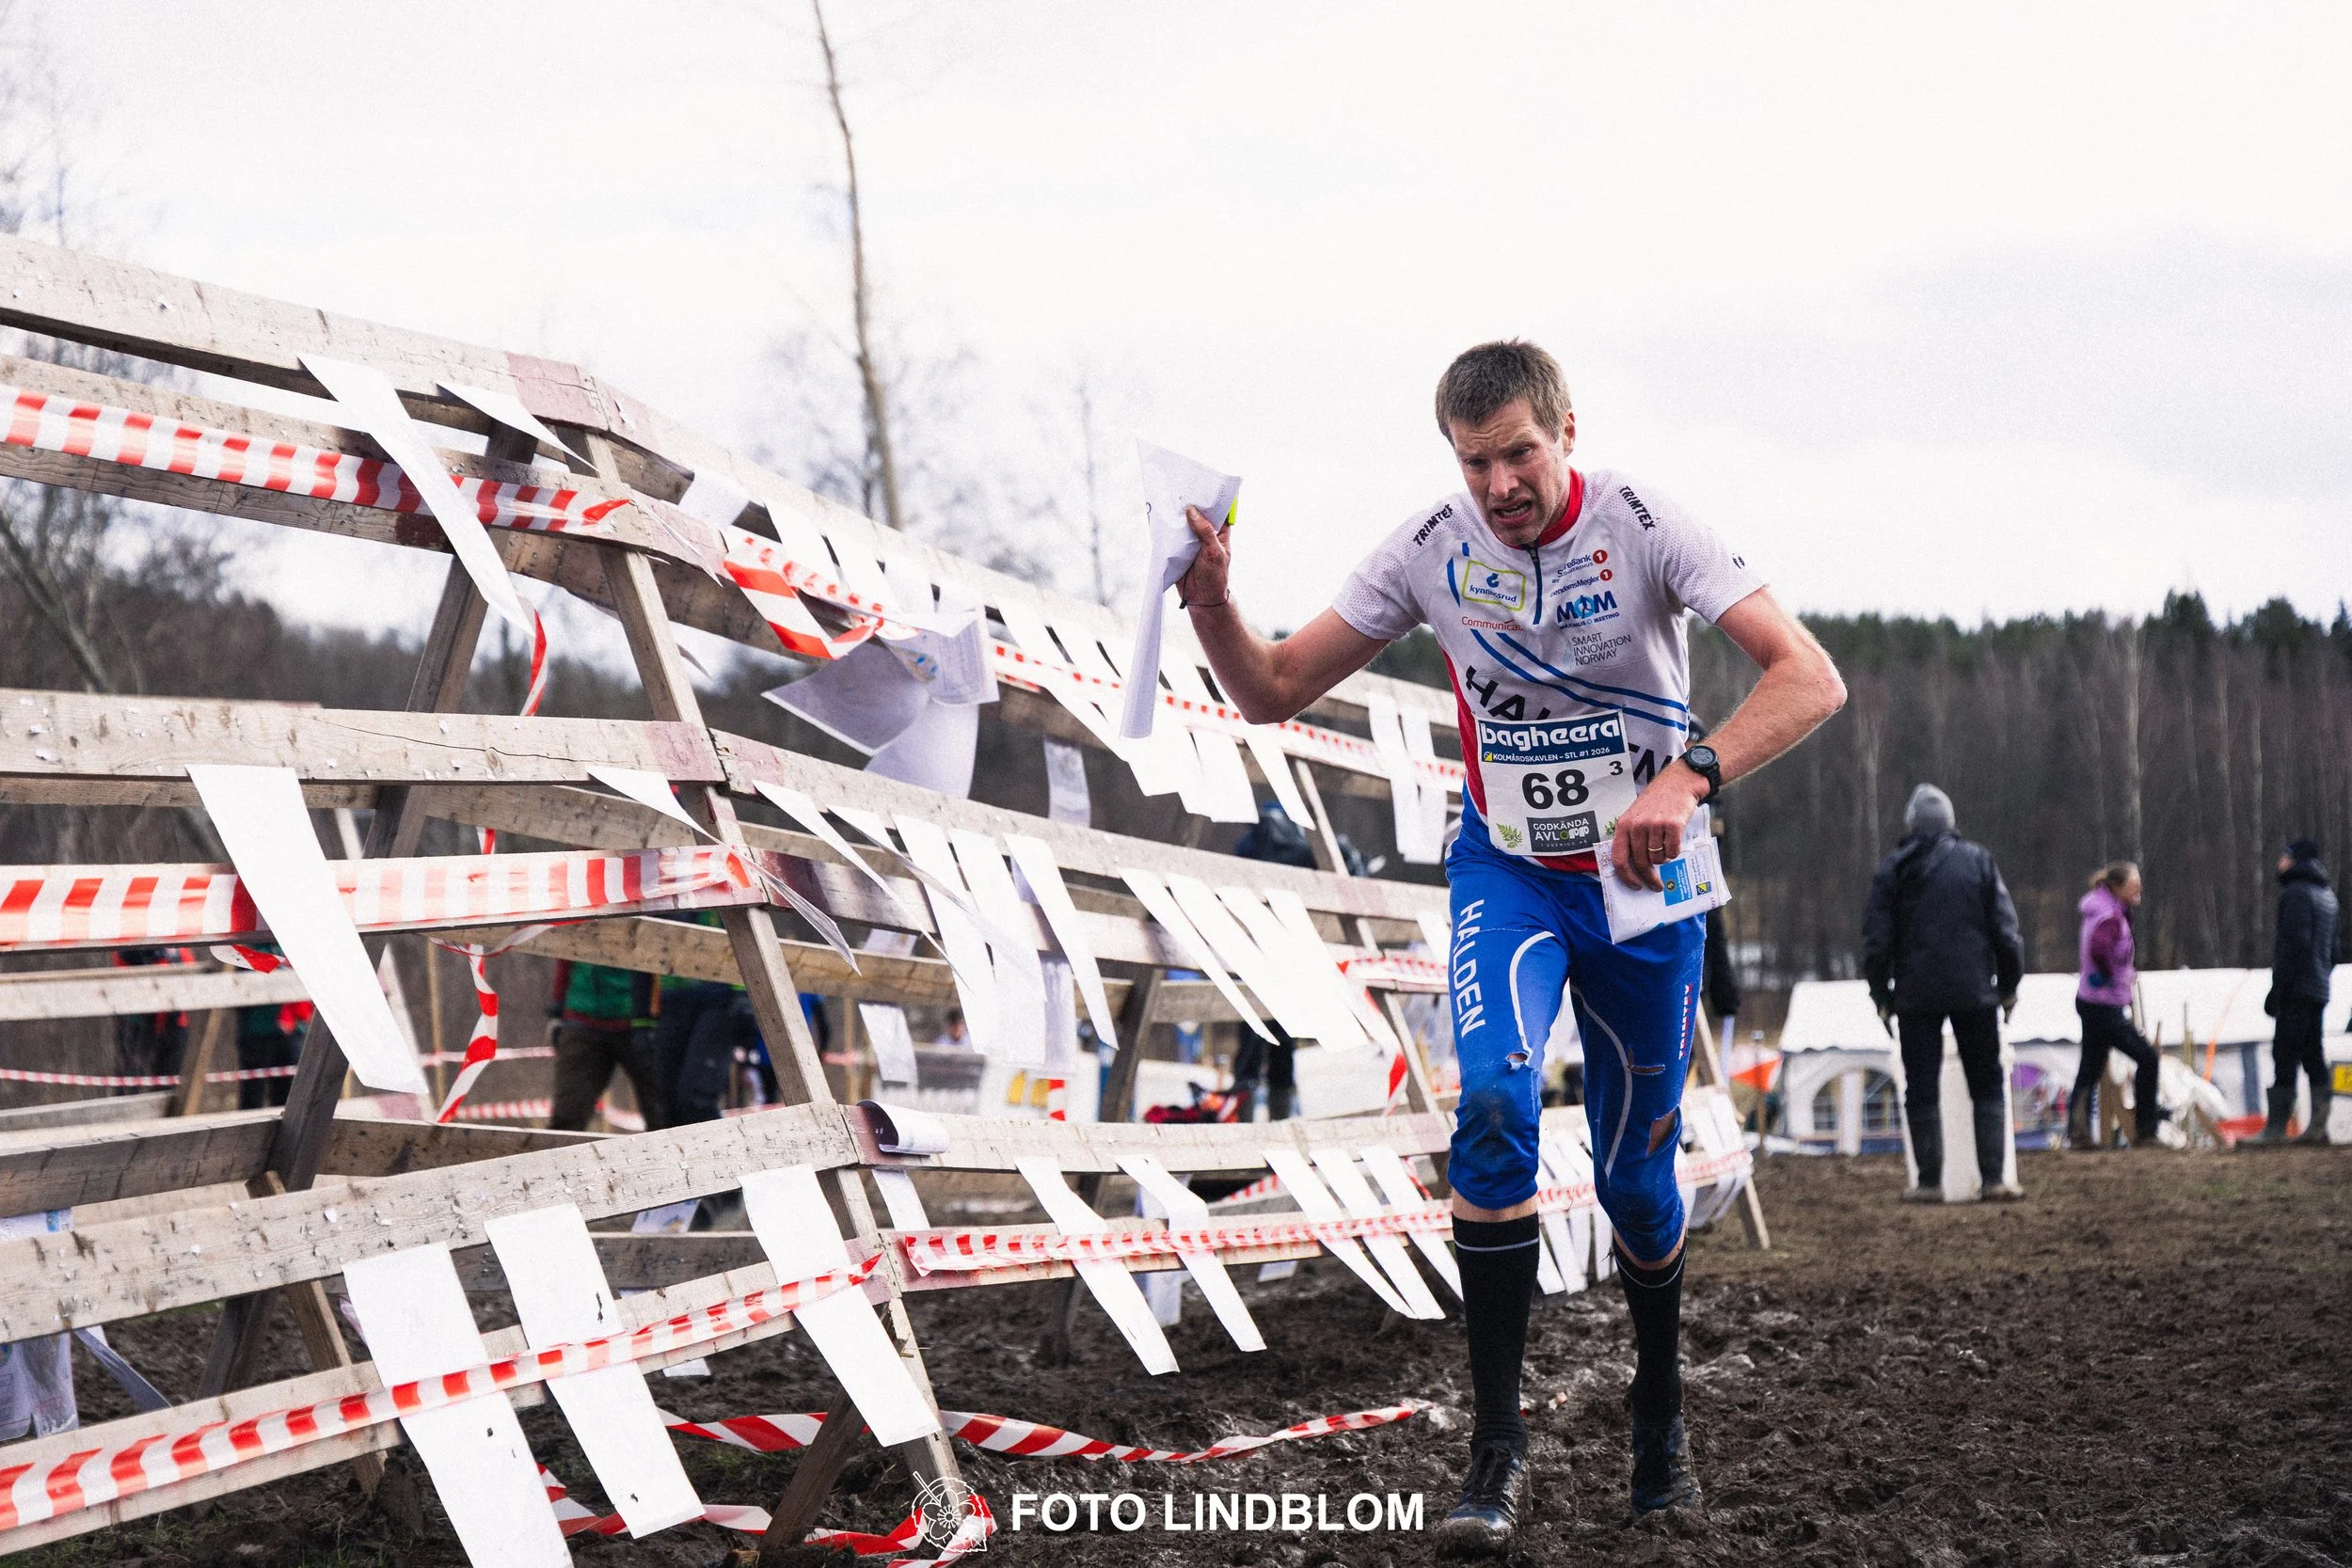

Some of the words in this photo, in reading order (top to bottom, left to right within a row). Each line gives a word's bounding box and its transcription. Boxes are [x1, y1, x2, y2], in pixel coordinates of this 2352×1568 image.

[1619, 485, 1656, 531] TRIMTEX
[1594, 611, 1619, 623] MEETING
[1571, 632, 1602, 646] SMART
[1573, 634, 1631, 656] INNOVATION
[1575, 648, 1617, 666] NORWAY
[1481, 719, 1621, 752] bagheera
[1493, 752, 1558, 763] KOLMÅRDSKAVLEN
[1565, 752, 1579, 760] STL
[1591, 747, 1610, 756] 2026
[1609, 760, 1624, 776] 3
[1521, 768, 1589, 810] 68
[1533, 817, 1590, 831] GODKÄNDA
[1453, 898, 1486, 1039] HALDEN
